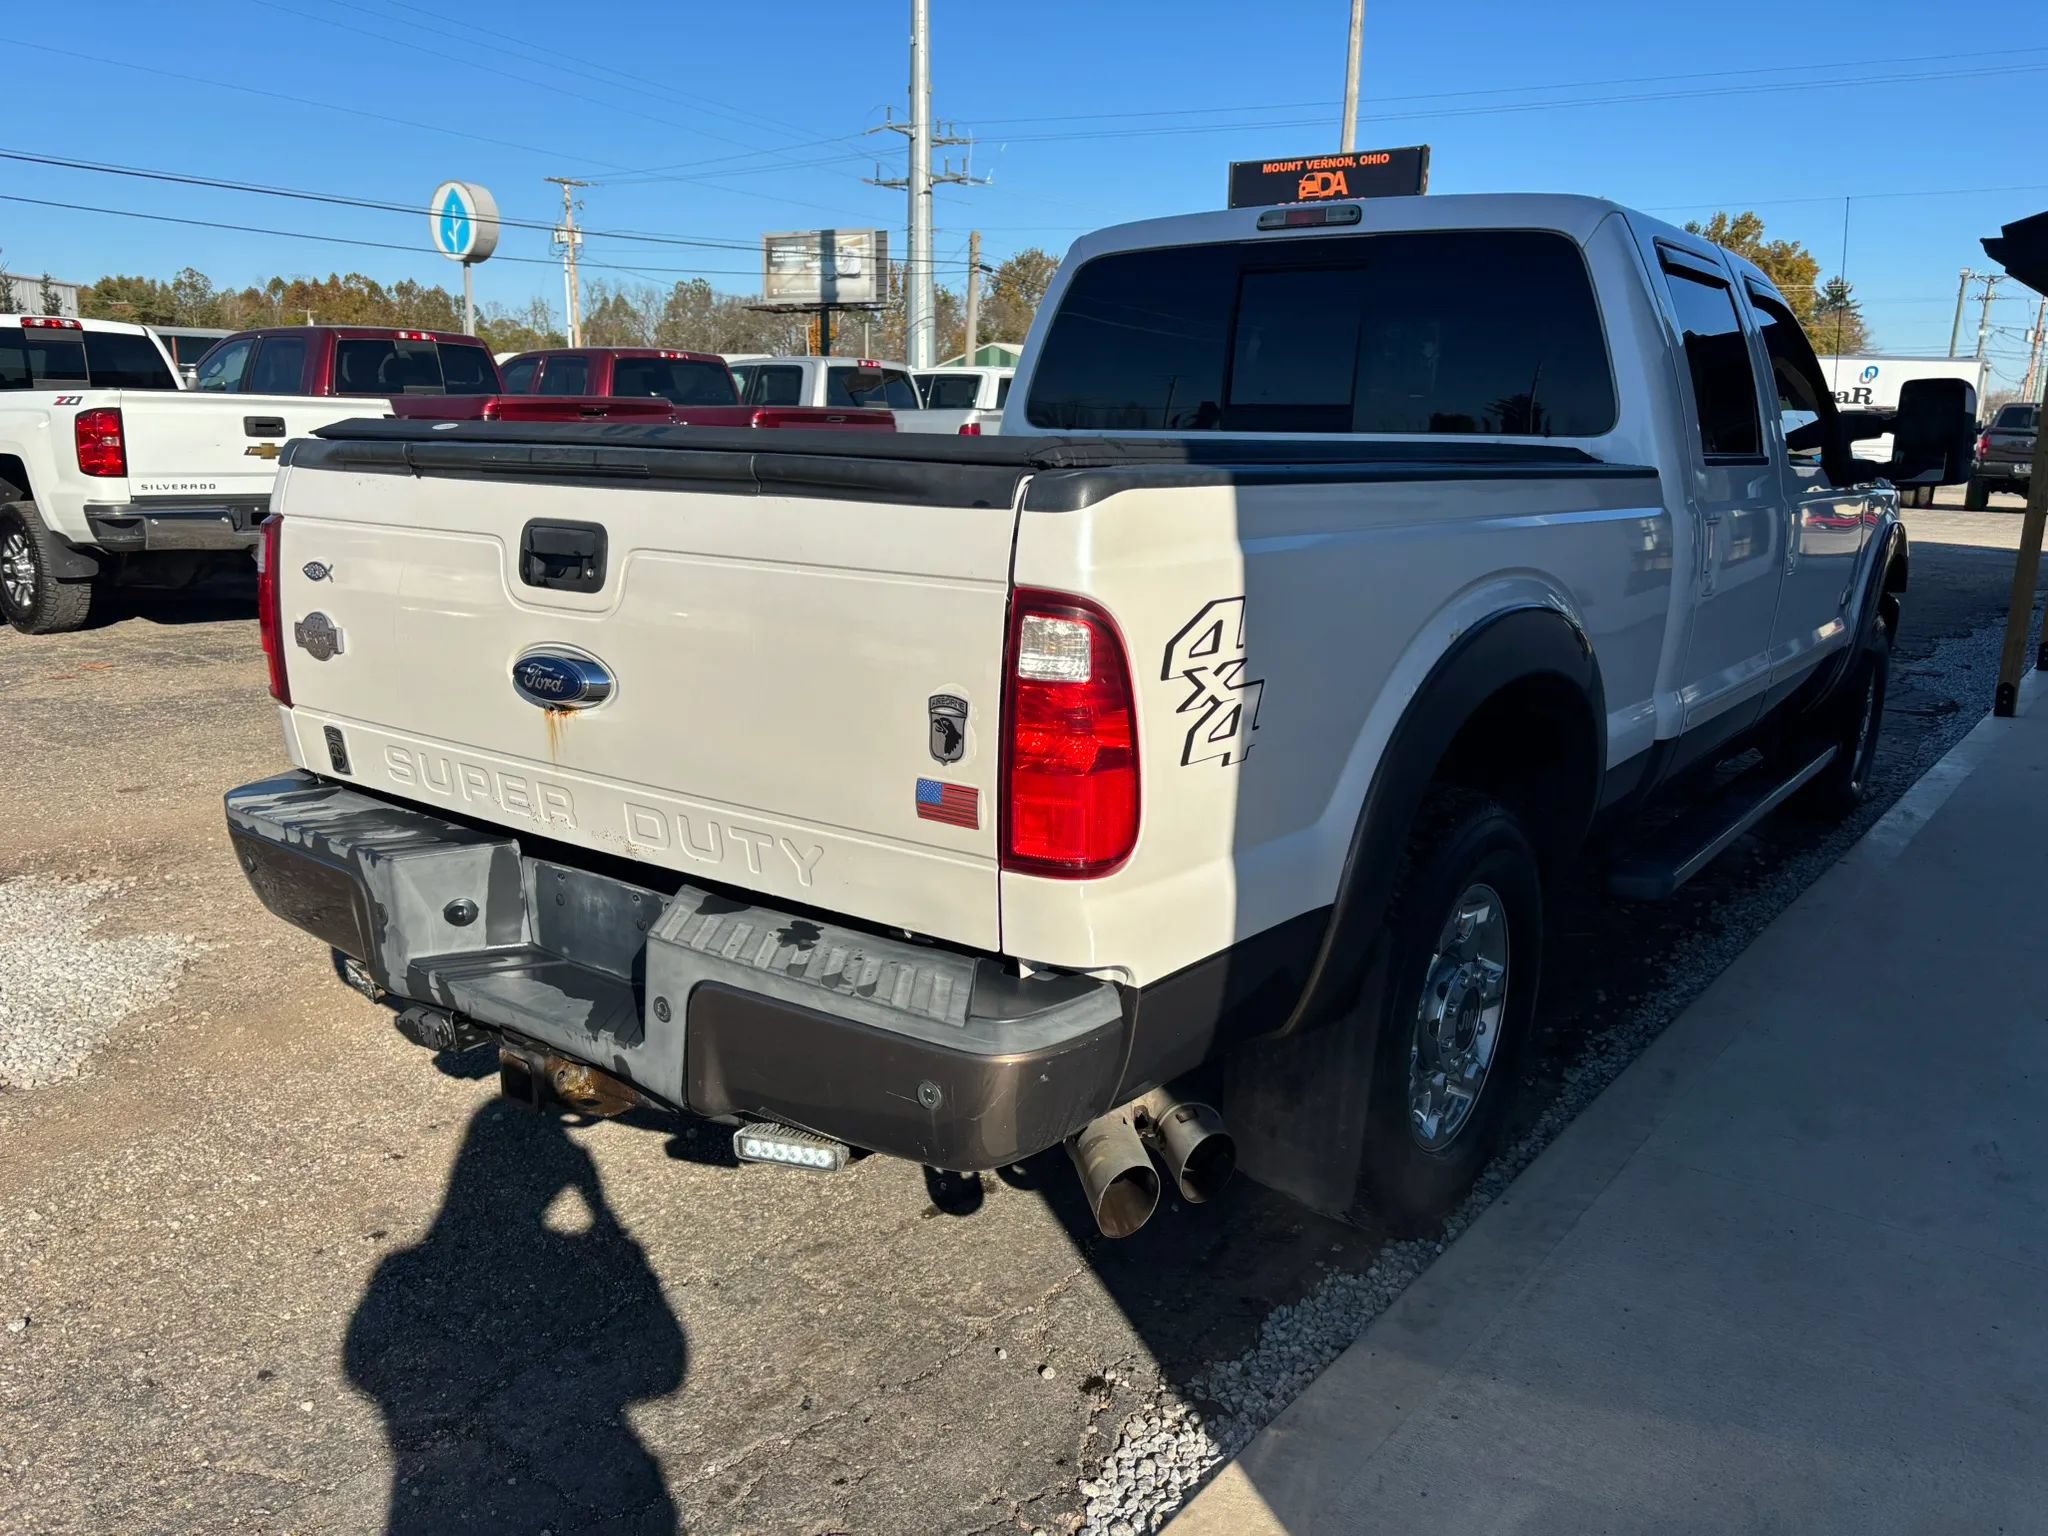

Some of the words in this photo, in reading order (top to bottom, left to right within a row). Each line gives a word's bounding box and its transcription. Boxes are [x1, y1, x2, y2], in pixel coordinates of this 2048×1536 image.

[1262, 161, 1304, 174] MOUNT
[1306, 156, 1357, 169] VERNON,
[1360, 153, 1390, 165] OHIO
[53, 395, 84, 406] Z71
[140, 483, 217, 491] SILVERADO
[519, 662, 565, 693] Ford
[931, 697, 965, 711] AIRBORNE
[384, 744, 578, 830] SUPER
[623, 801, 826, 888] DUTY
